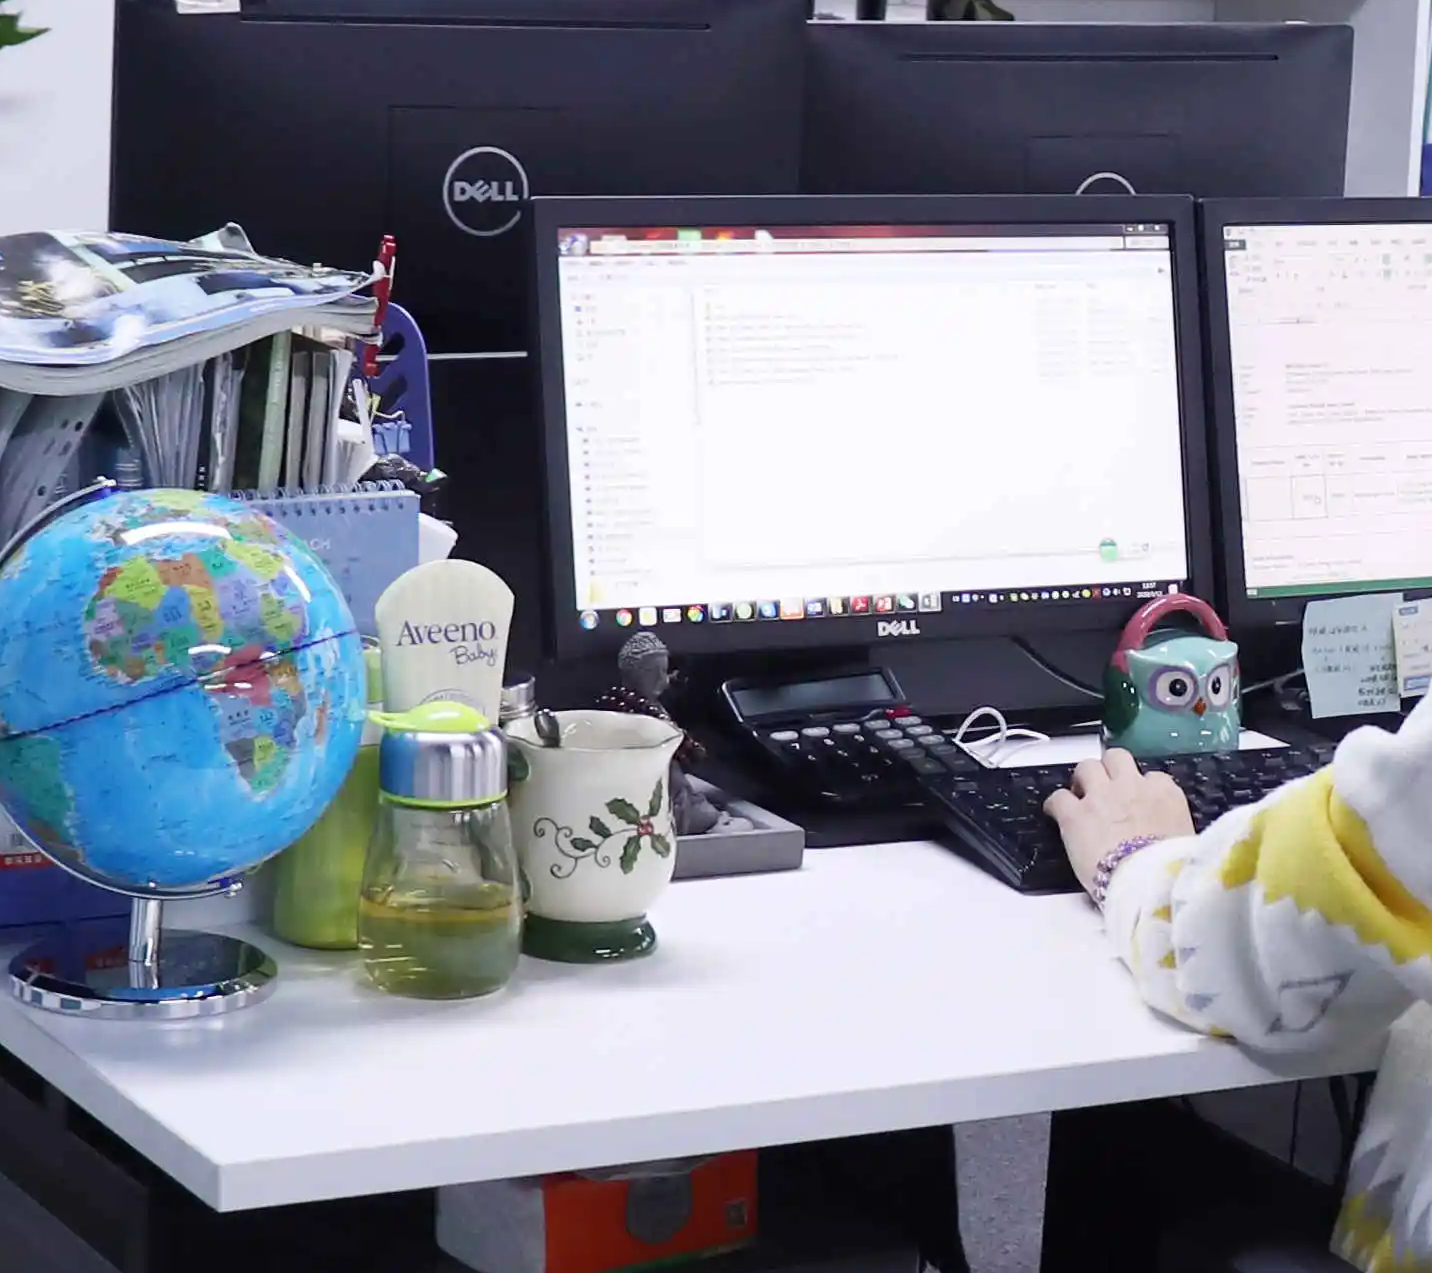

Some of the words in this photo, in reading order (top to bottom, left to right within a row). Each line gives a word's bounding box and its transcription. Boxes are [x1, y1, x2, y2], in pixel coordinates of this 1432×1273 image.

[453, 179, 519, 203] DELL
[395, 619, 497, 647] Aveeno
[877, 619, 921, 637] DELL
[449, 641, 499, 667] Baby
